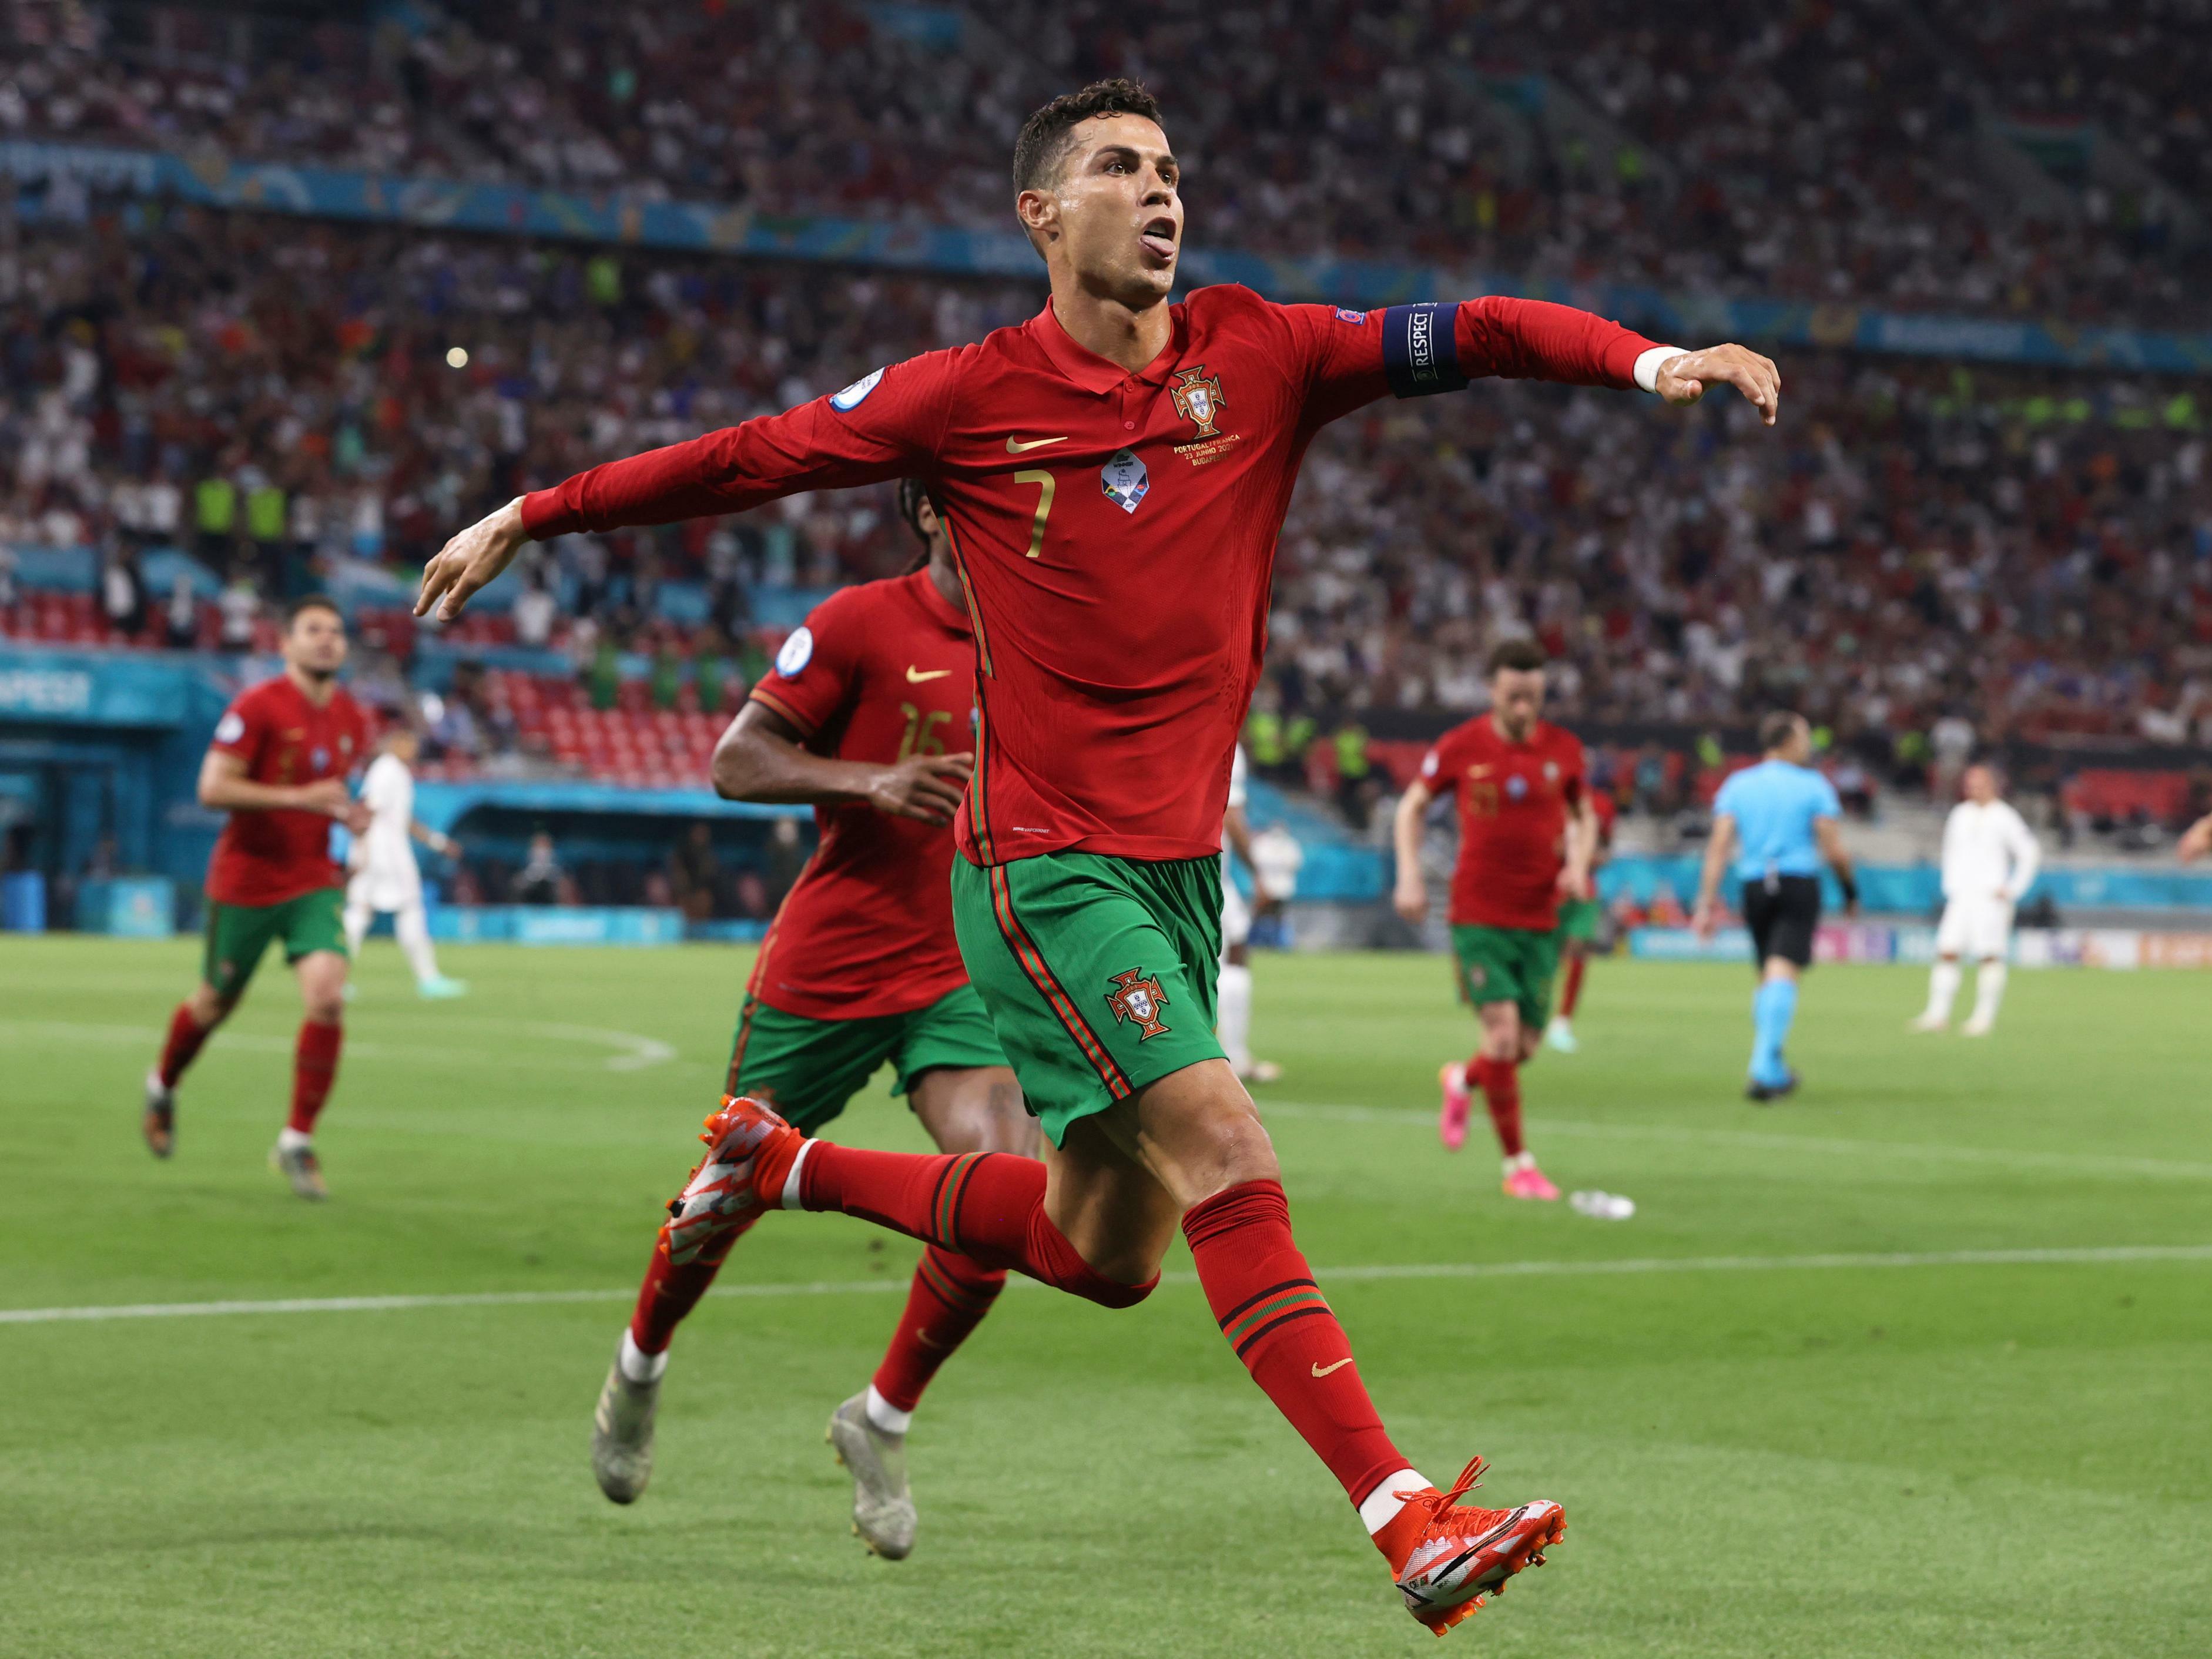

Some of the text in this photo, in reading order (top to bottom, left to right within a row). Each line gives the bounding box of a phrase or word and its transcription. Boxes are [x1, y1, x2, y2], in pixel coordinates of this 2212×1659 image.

[1413, 313, 1429, 366] RESPECT
[1196, 447, 1216, 457] JUNHO
[1014, 470, 1055, 558] 7
